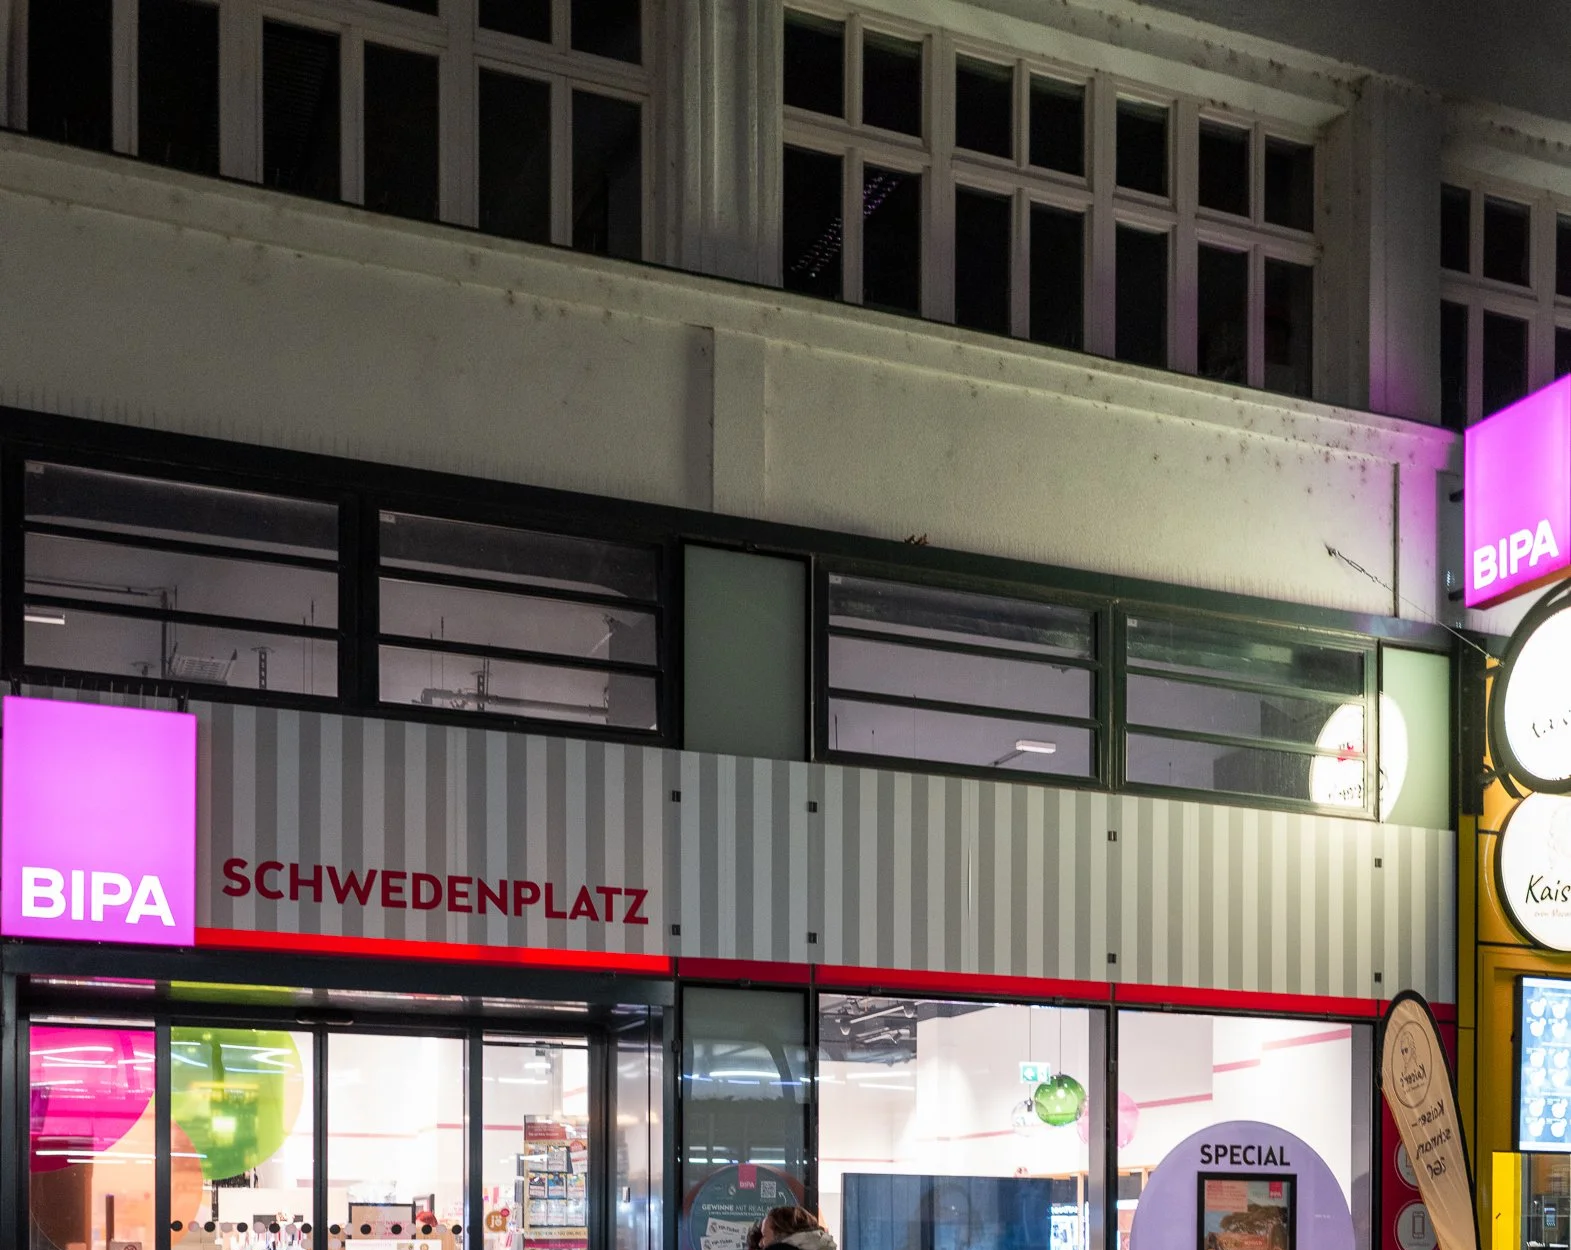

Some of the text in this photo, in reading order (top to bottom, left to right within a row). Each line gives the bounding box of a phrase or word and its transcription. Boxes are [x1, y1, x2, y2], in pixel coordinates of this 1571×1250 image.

[1473, 518, 1560, 591] BIPA
[20, 866, 176, 928] BIPA
[221, 857, 650, 925] SCHWEDENPLATZ
[1200, 1144, 1291, 1167] SPECIAL
[701, 1203, 734, 1211] GEWINNE
